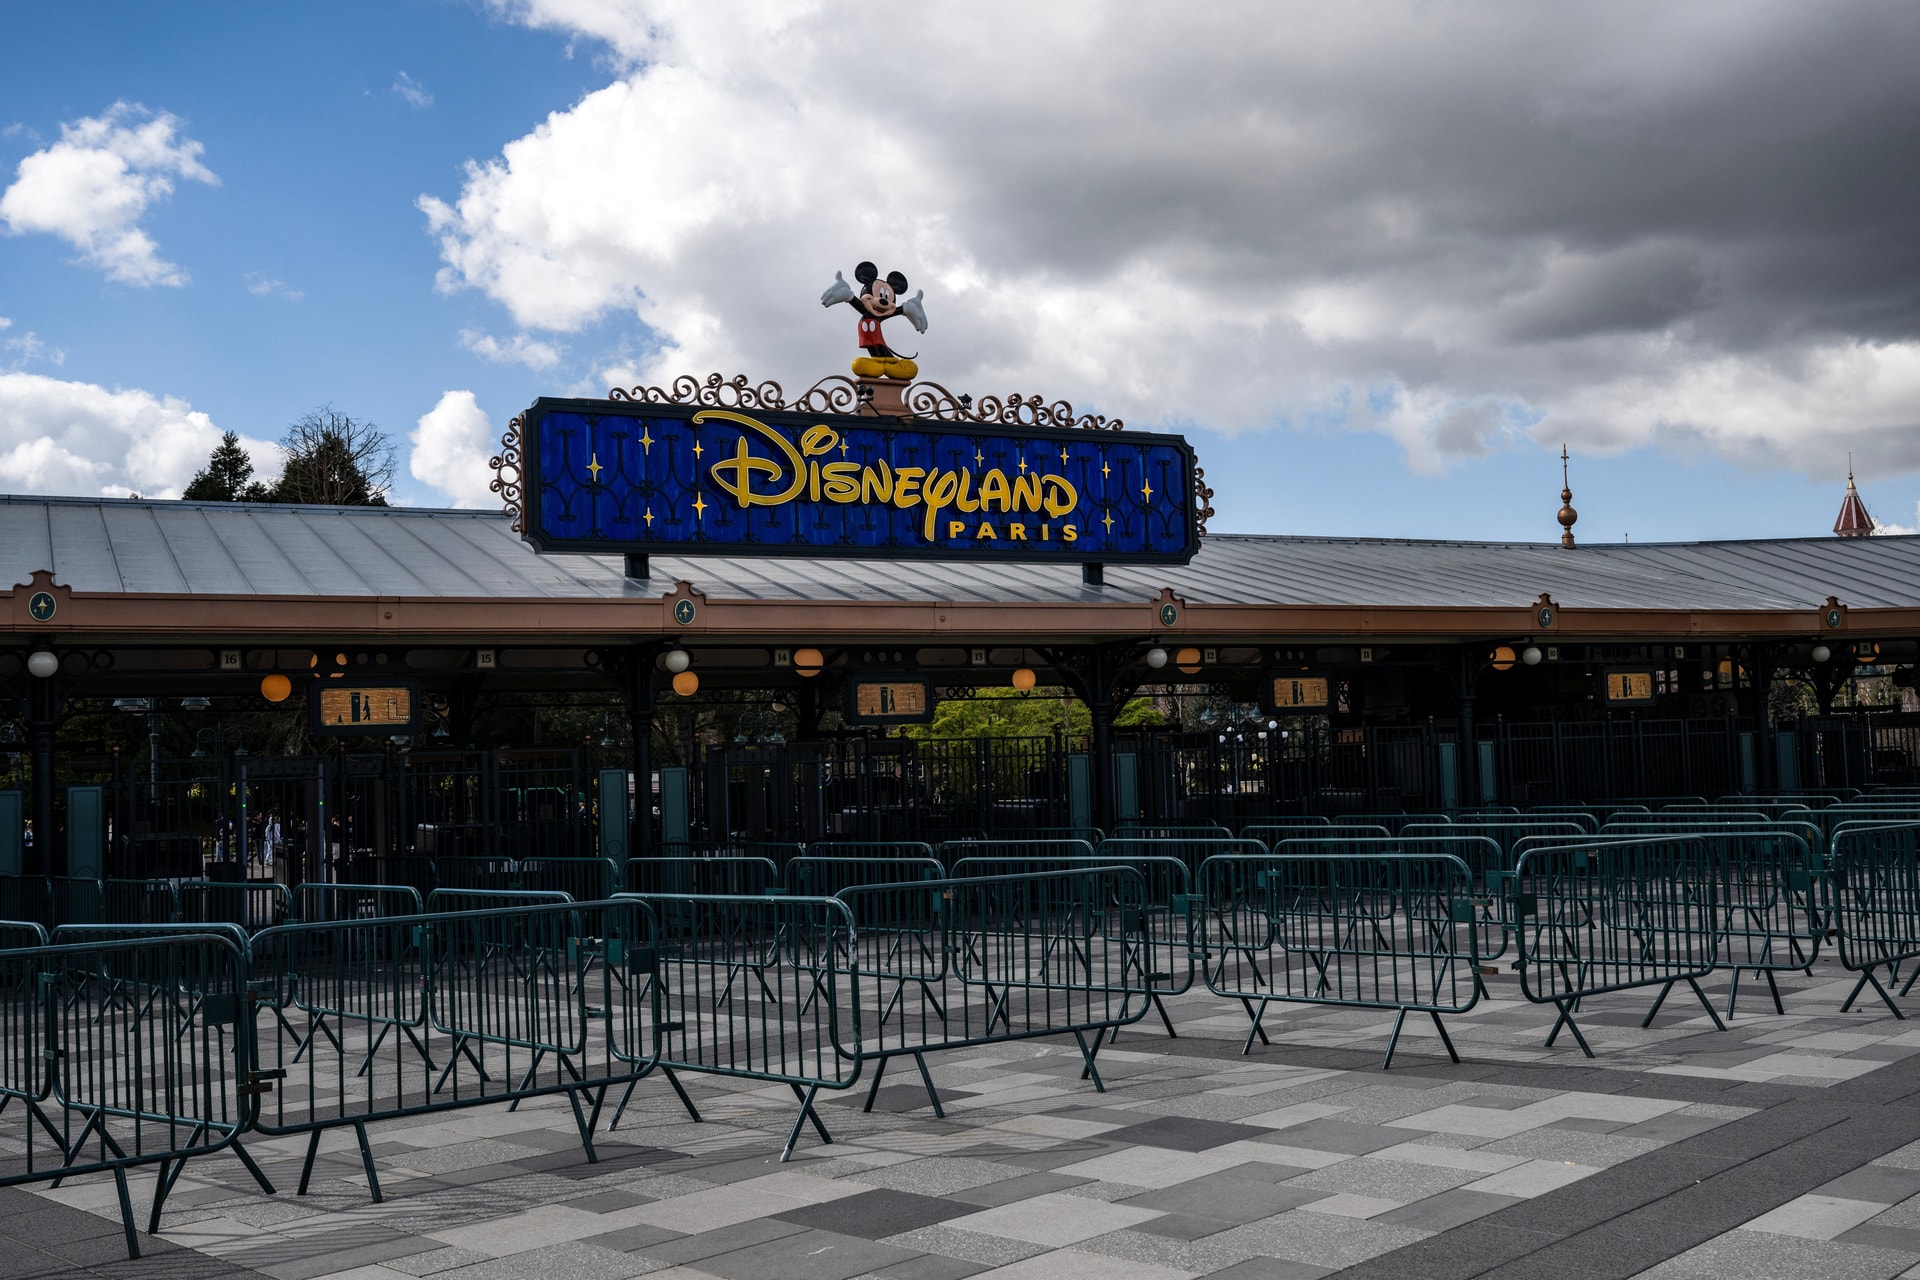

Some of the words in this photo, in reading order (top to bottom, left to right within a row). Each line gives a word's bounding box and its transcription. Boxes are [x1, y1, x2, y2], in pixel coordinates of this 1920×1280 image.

[949, 521, 1078, 541] PARIS
[225, 654, 237, 664] 16
[481, 654, 491, 663] 15
[778, 653, 787, 661] 14
[975, 652, 983, 660] 13
[1207, 652, 1214, 660] 12
[1363, 651, 1370, 659] 11
